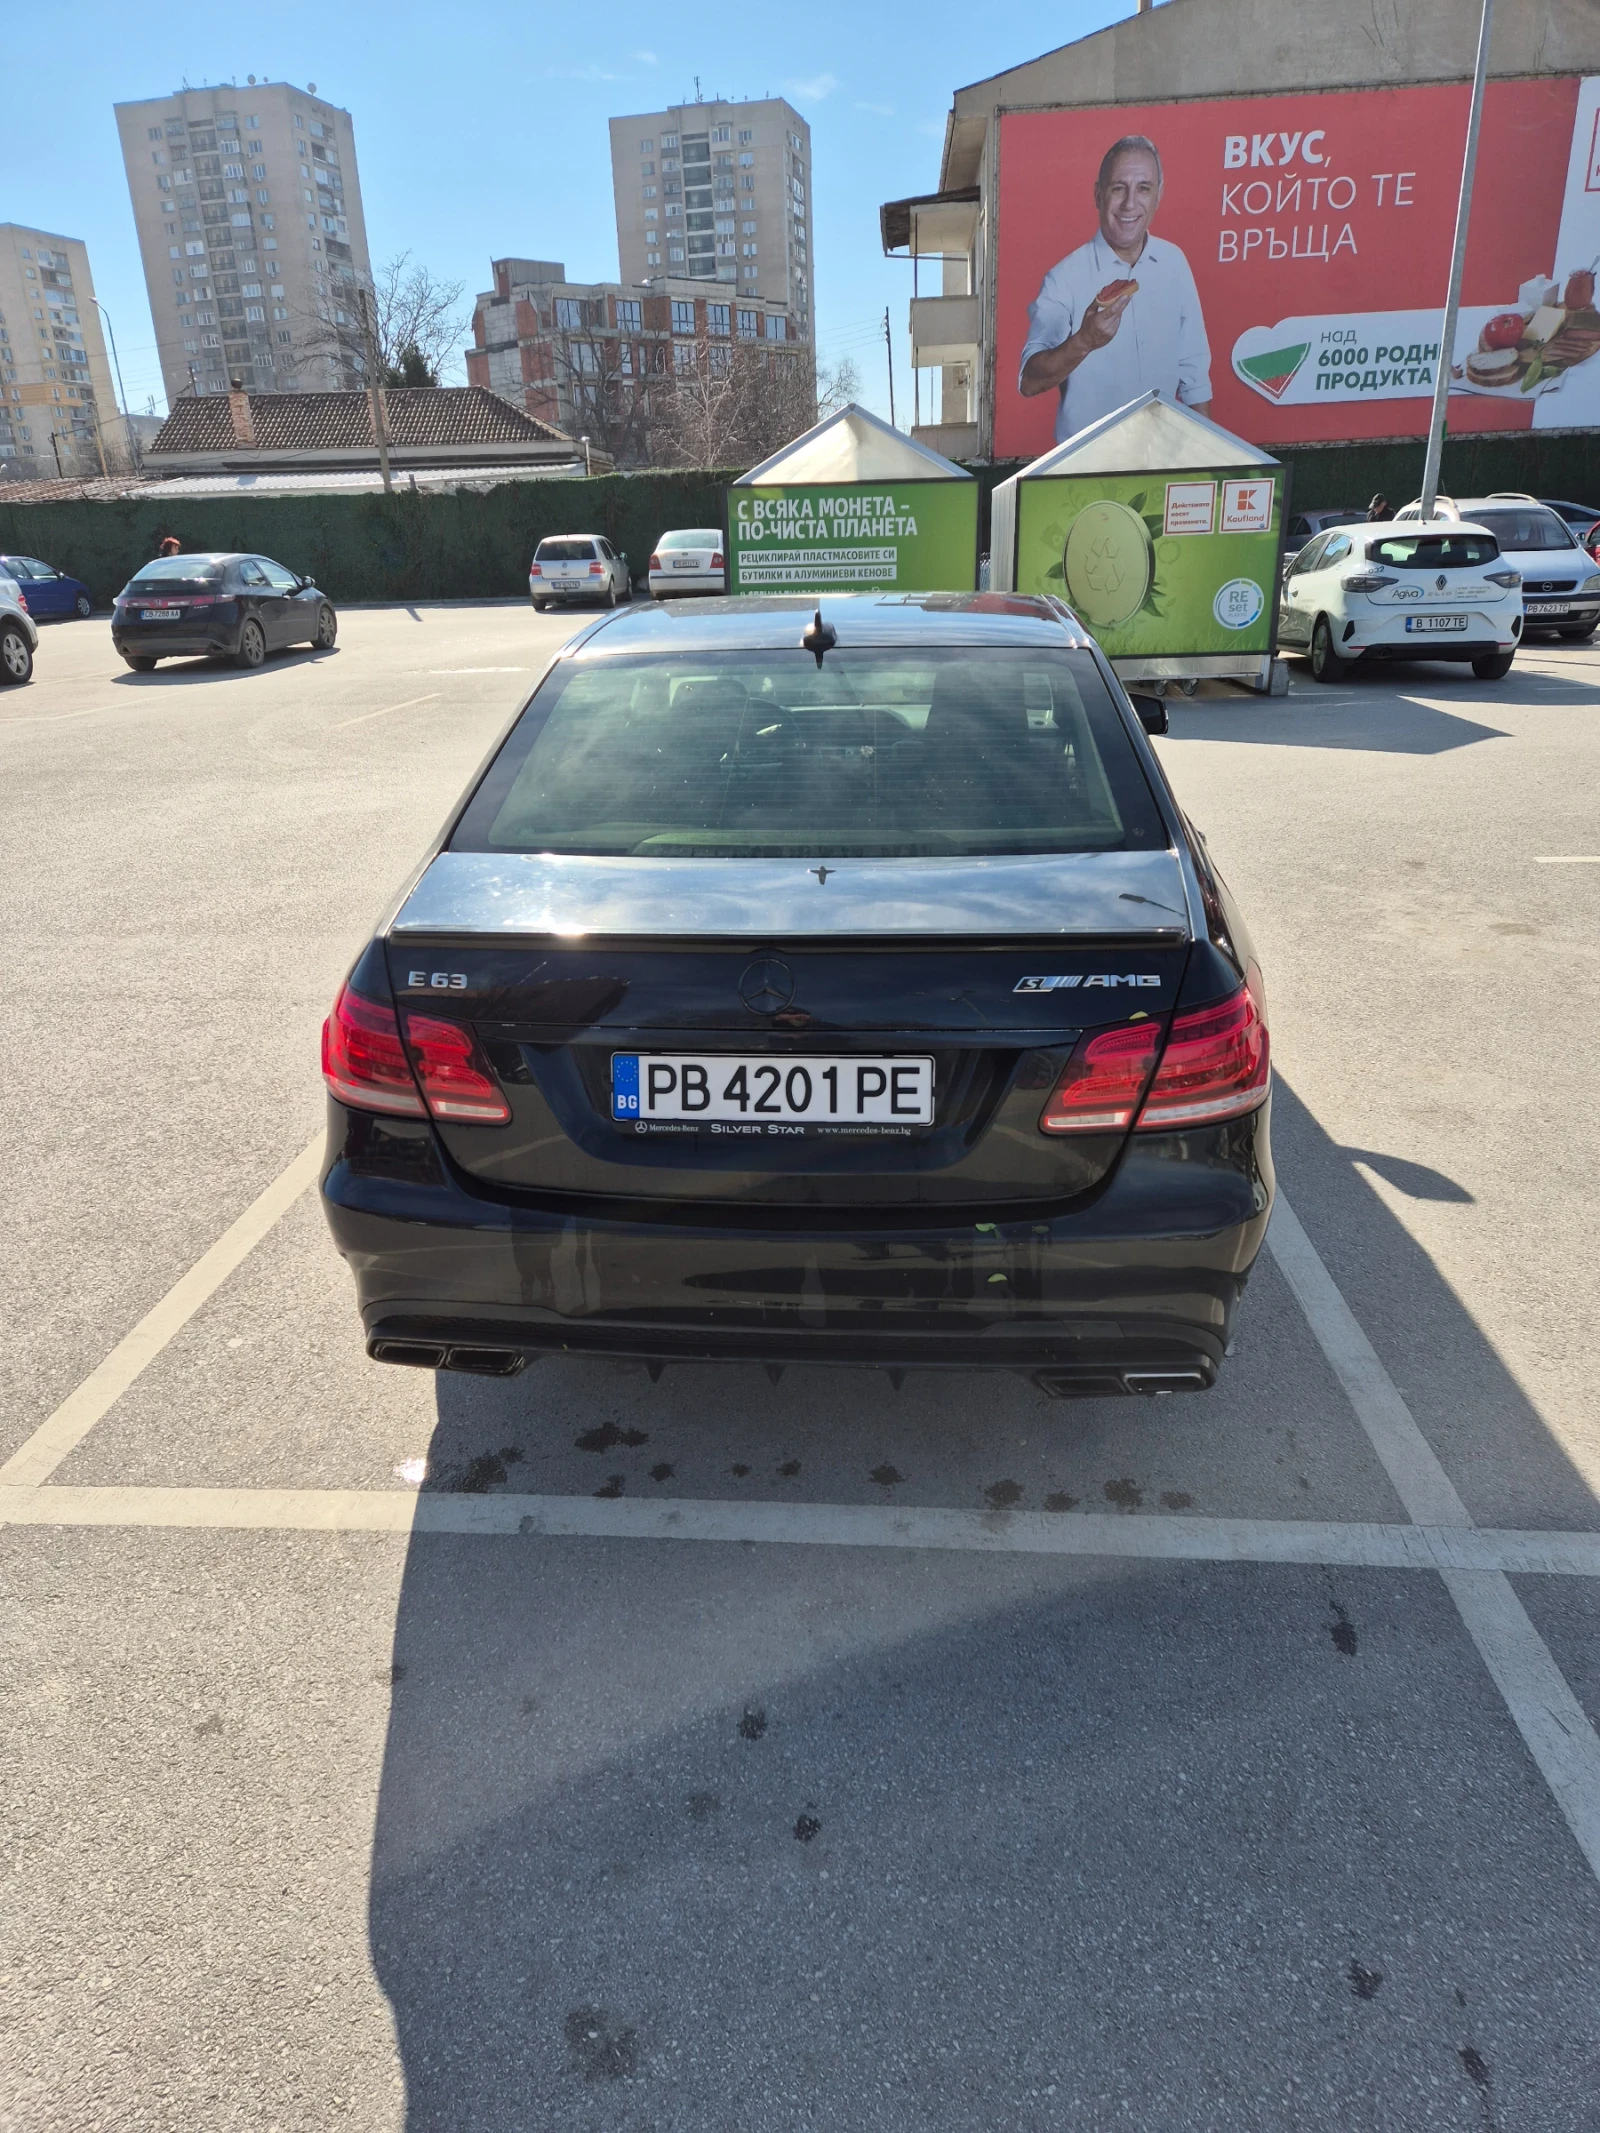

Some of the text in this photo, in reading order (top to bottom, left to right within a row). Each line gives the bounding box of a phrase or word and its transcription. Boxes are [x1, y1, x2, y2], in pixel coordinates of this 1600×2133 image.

[1223, 130, 1332, 169] ВКУС,
[1221, 172, 1416, 215] КОЙТО ТЕ
[1218, 223, 1358, 263] ВРЪЩА
[1320, 329, 1357, 345] над
[1318, 347, 1369, 367] 6000
[1315, 367, 1432, 391] ПРОДУКТА
[753, 498, 814, 520] ВСЯКА
[818, 496, 896, 518] МОНЕТА
[1227, 514, 1265, 523] Kaufland
[738, 516, 918, 541] ПО-ЧИСТА ПЛАНЕТА
[741, 549, 895, 564] РЕЦИКЛИРАЙ ПЛАСТМАСОВИТЕ СИ
[741, 567, 893, 581] БУТИЛКИ И АЛУМИНИЕВИ КЕНОВЕ
[1229, 590, 1249, 603] RE
[1392, 589, 1419, 600] Agiva
[1228, 602, 1249, 612] set
[1539, 604, 1558, 613] 7623
[1416, 617, 1465, 629] B 1107 TE
[408, 970, 468, 990] E 63
[1082, 974, 1162, 988] AMG
[648, 1064, 921, 1115] PB 4201 PE
[617, 1094, 638, 1110] BG
[649, 1124, 700, 1133] Mercedes-Benz
[817, 1126, 912, 1136] www.mercedes-benz.bg
